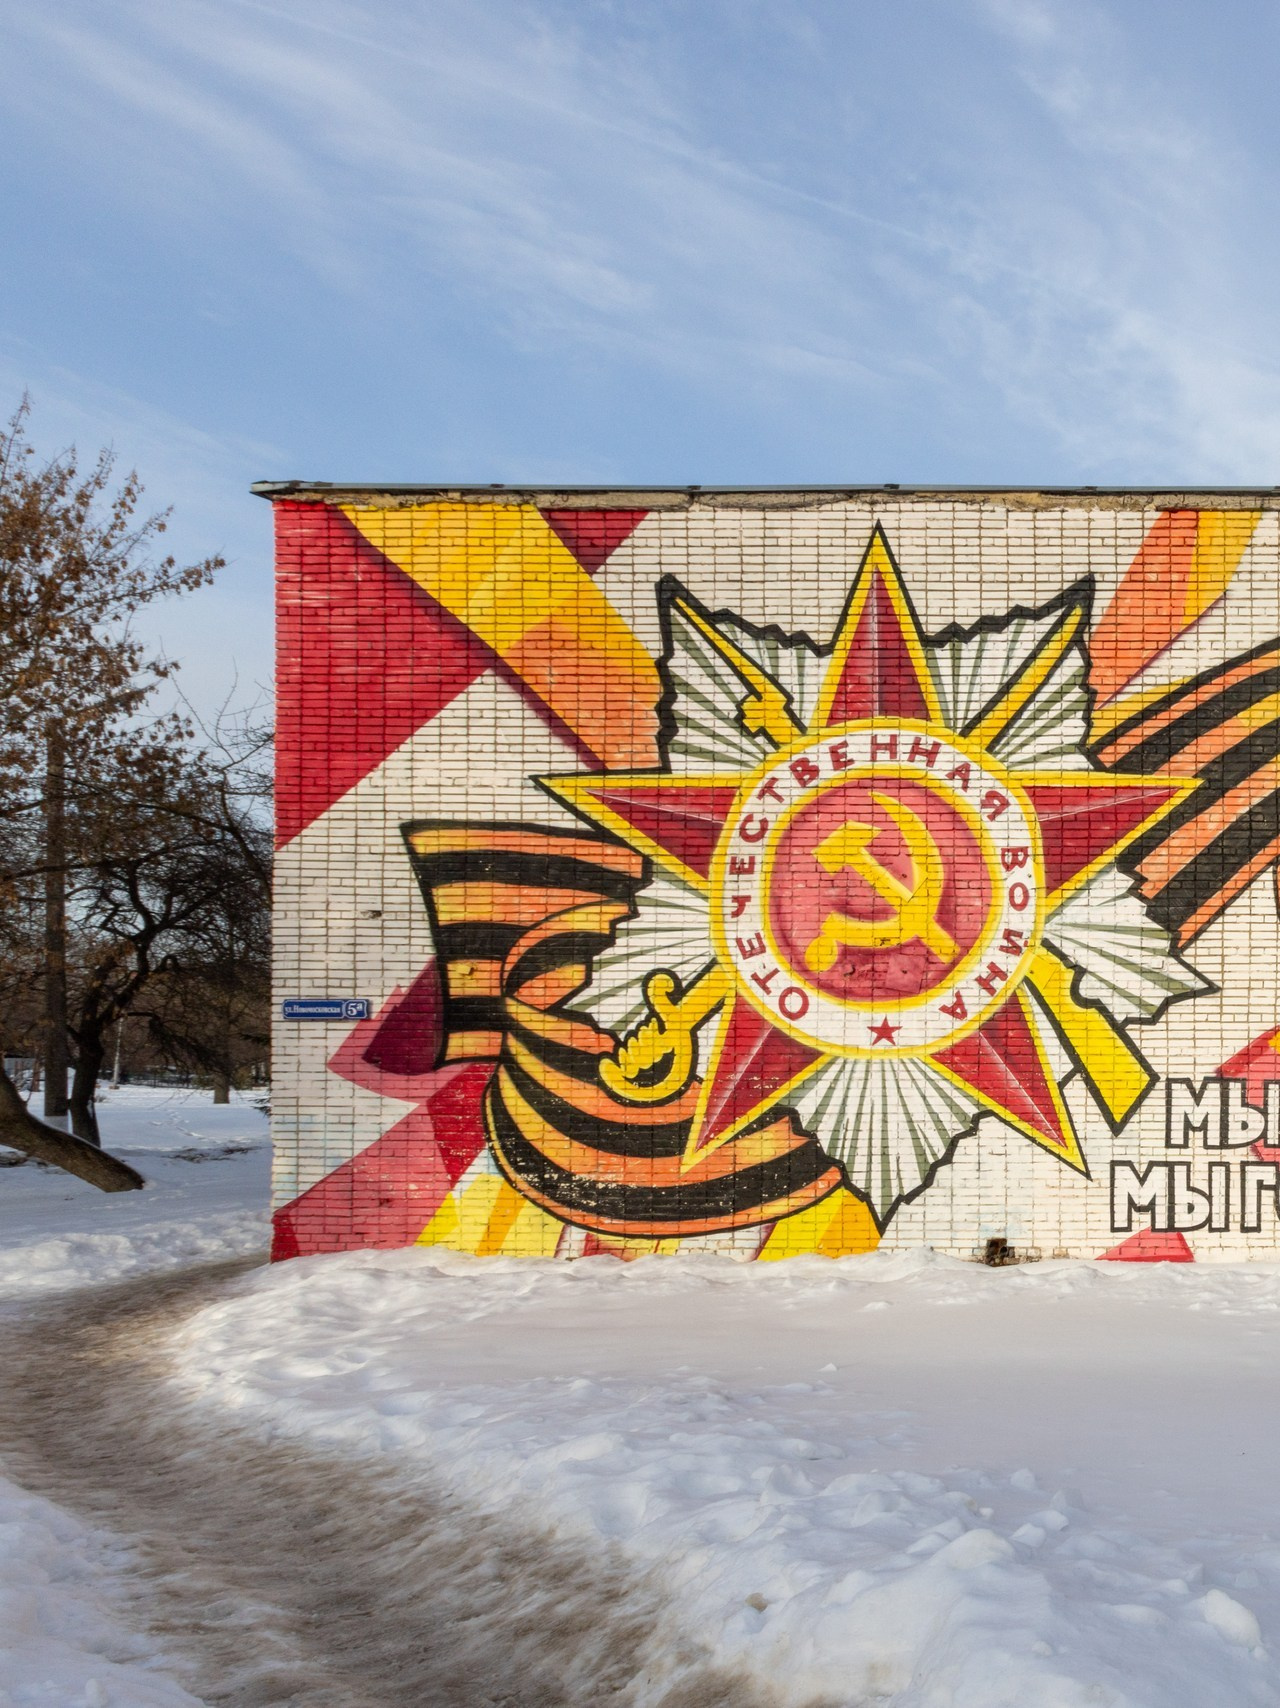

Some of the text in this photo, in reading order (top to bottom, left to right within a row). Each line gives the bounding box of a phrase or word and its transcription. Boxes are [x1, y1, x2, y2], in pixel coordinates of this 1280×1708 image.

[728, 734, 1030, 1021] ОТЕЧЕСТВЕННАЯ ВОЙНА
[1109, 1160, 1230, 1233] МЫ
